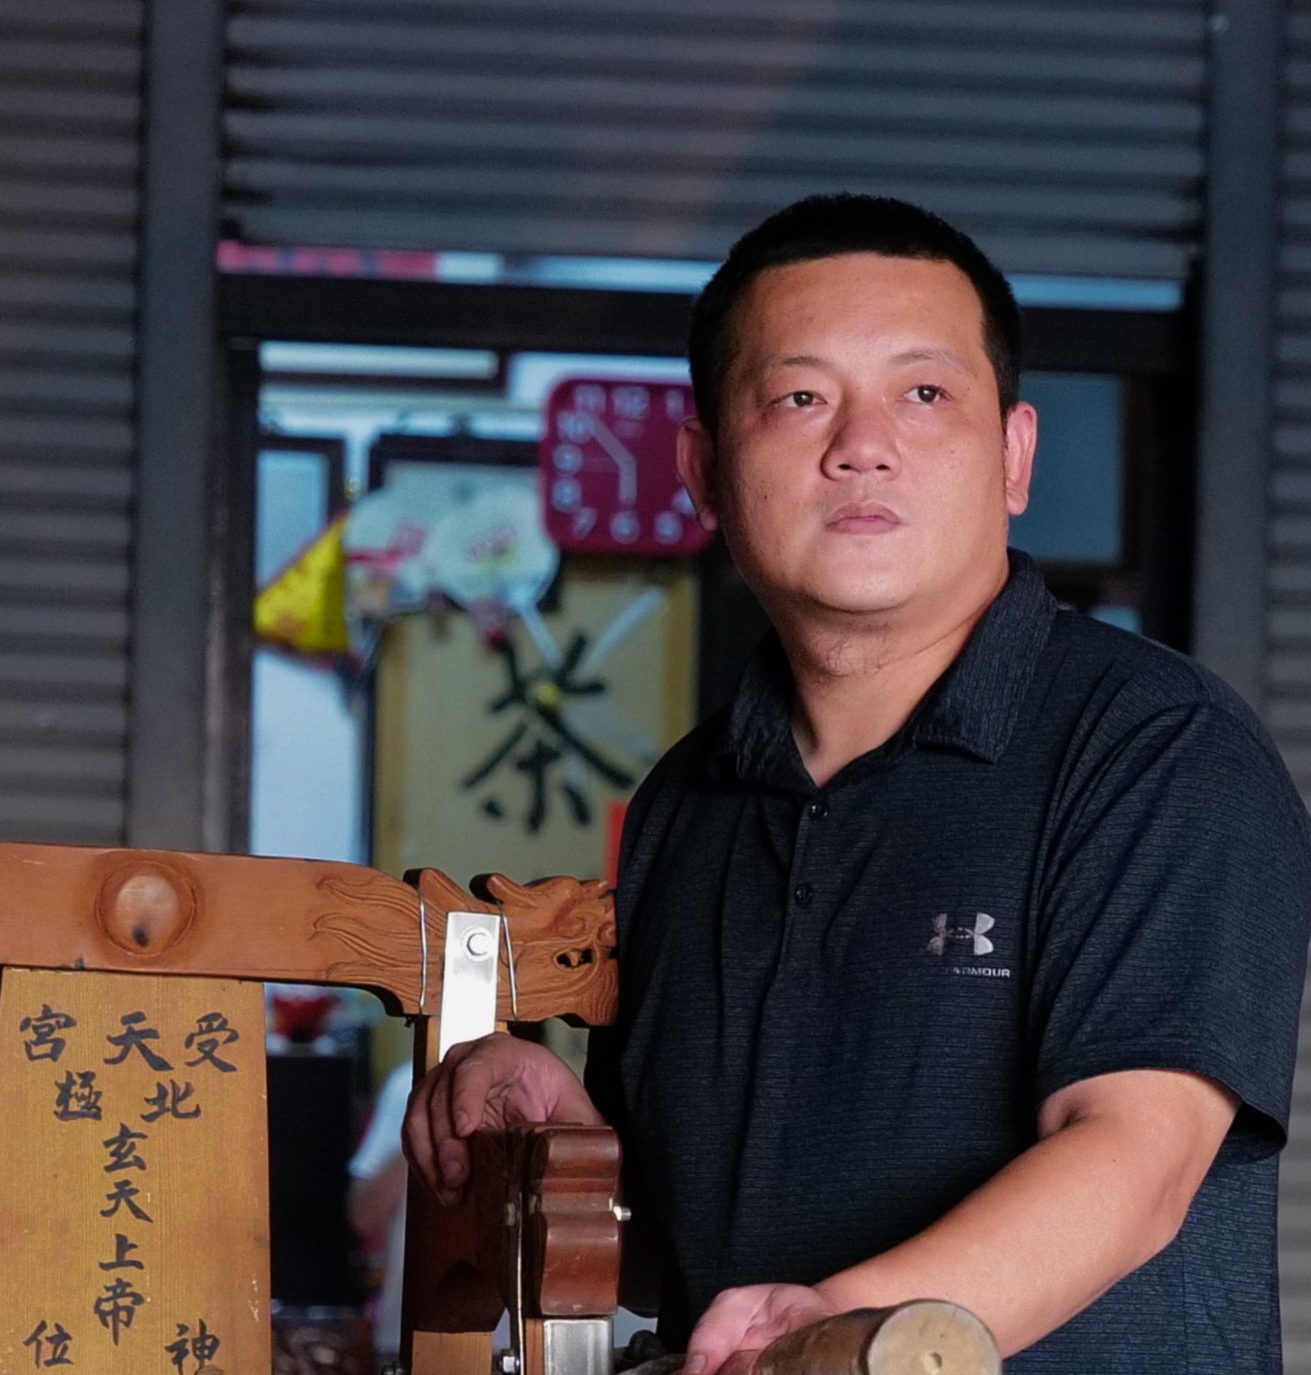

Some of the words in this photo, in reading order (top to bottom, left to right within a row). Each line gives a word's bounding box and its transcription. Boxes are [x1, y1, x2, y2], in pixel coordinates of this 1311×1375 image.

[462, 634, 635, 833] 茶
[953, 966, 1010, 978] ARMOUR
[94, 1123, 153, 1345] 玄天上帝
